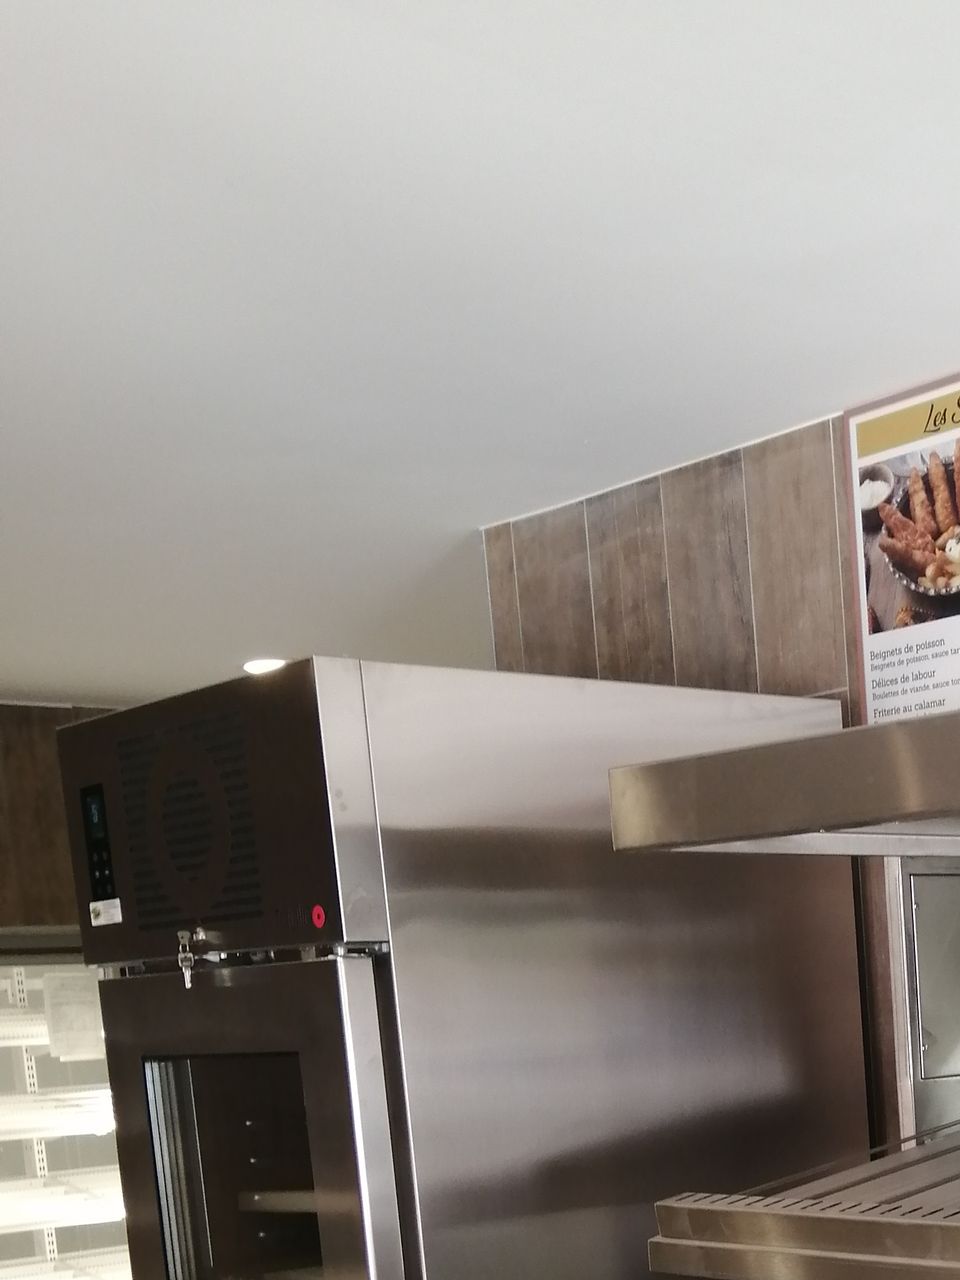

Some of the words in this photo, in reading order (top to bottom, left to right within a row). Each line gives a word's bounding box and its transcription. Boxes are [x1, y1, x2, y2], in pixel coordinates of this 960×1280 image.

[923, 403, 948, 433] Les
[869, 647, 902, 661] Beignets
[903, 643, 913, 654] de
[915, 638, 945, 653] poisson
[896, 657, 904, 666] de
[931, 649, 948, 659] sauce
[871, 677, 898, 689] Délices
[899, 672, 909, 684] de
[911, 669, 935, 681] labour
[871, 689, 899, 701] Boulettes
[900, 686, 908, 695] de
[931, 680, 949, 689] sauce
[873, 705, 900, 718] Friterie
[902, 704, 912, 713] au
[913, 698, 945, 710] calamar
